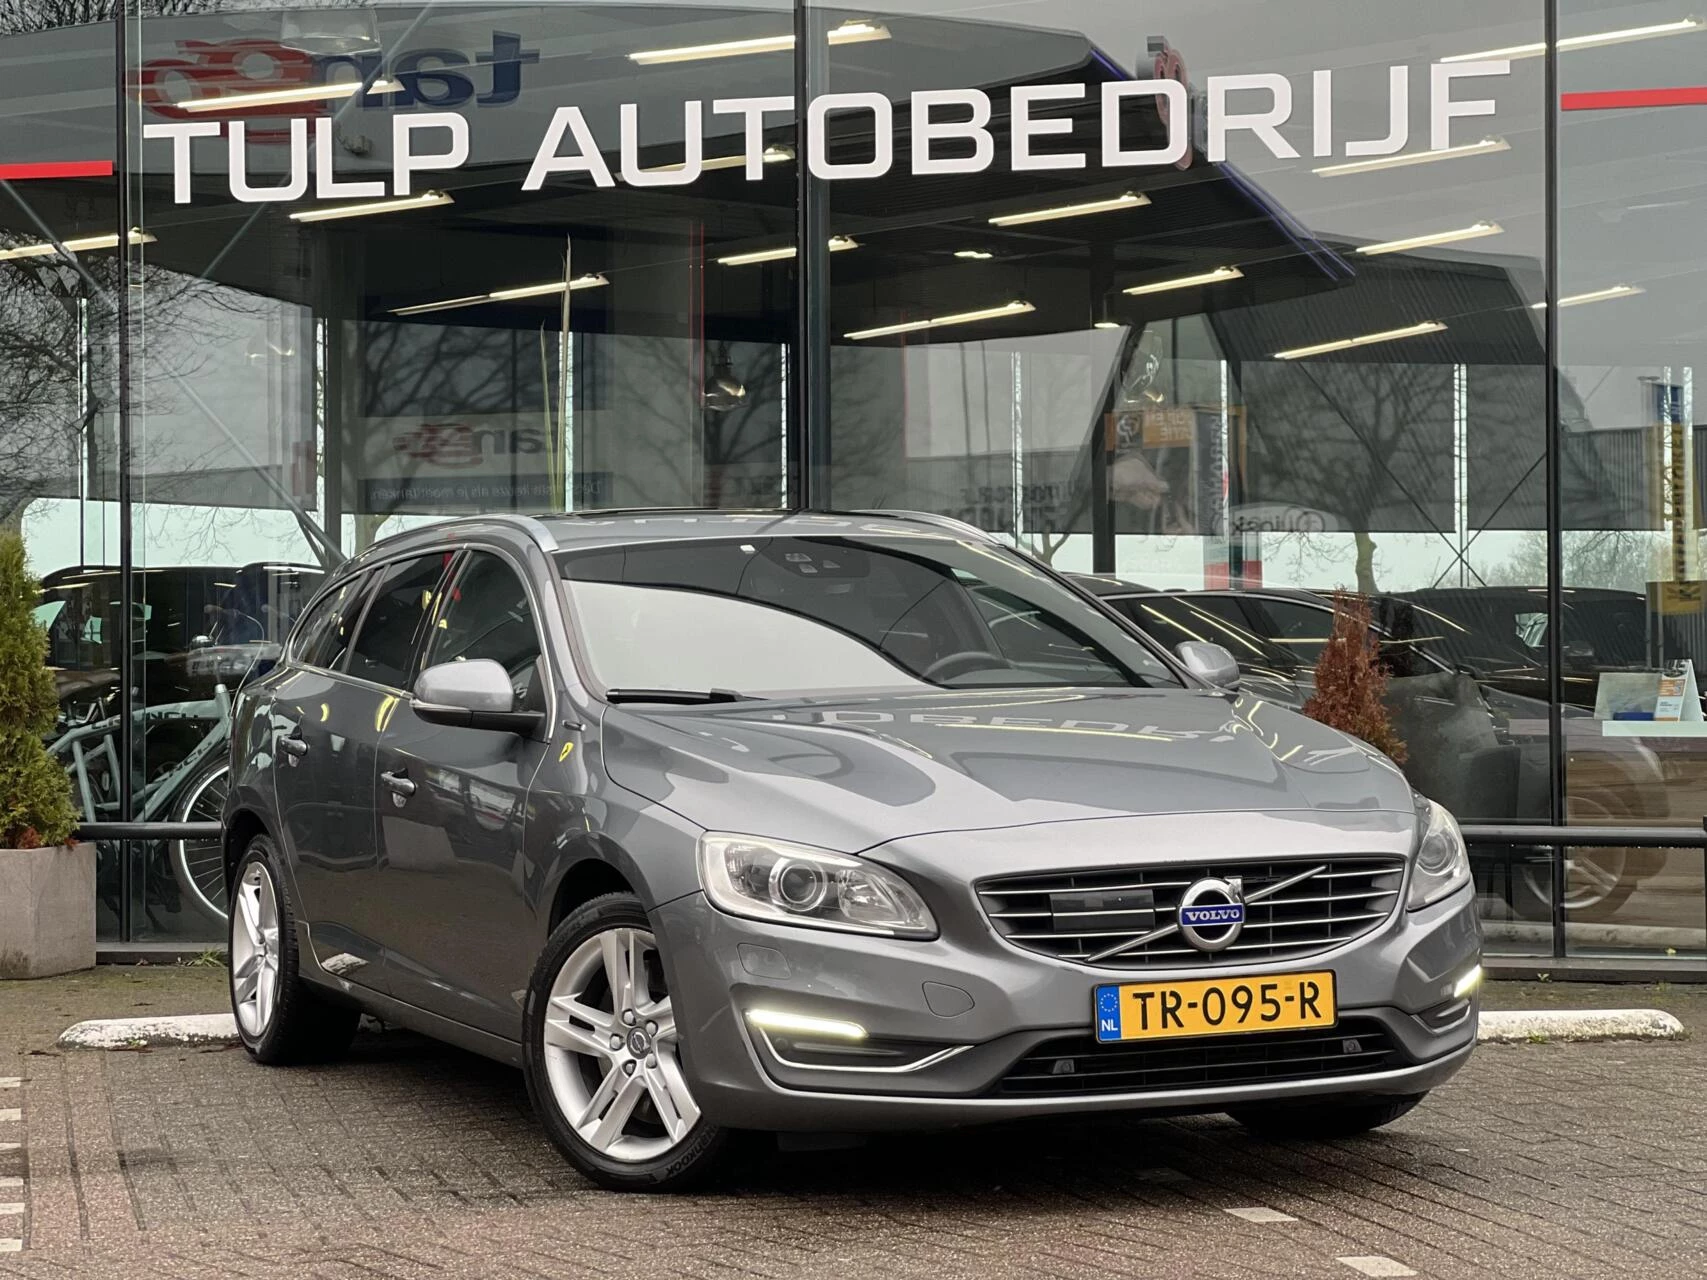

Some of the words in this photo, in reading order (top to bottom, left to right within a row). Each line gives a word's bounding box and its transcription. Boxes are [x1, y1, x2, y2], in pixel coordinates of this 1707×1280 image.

[143, 112, 469, 204] TULP
[522, 58, 1511, 192] AUTOBEDRIJF
[1185, 906, 1241, 923] VOLVO
[1101, 1019, 1119, 1033] NL
[1133, 981, 1322, 1031] TR-095-R
